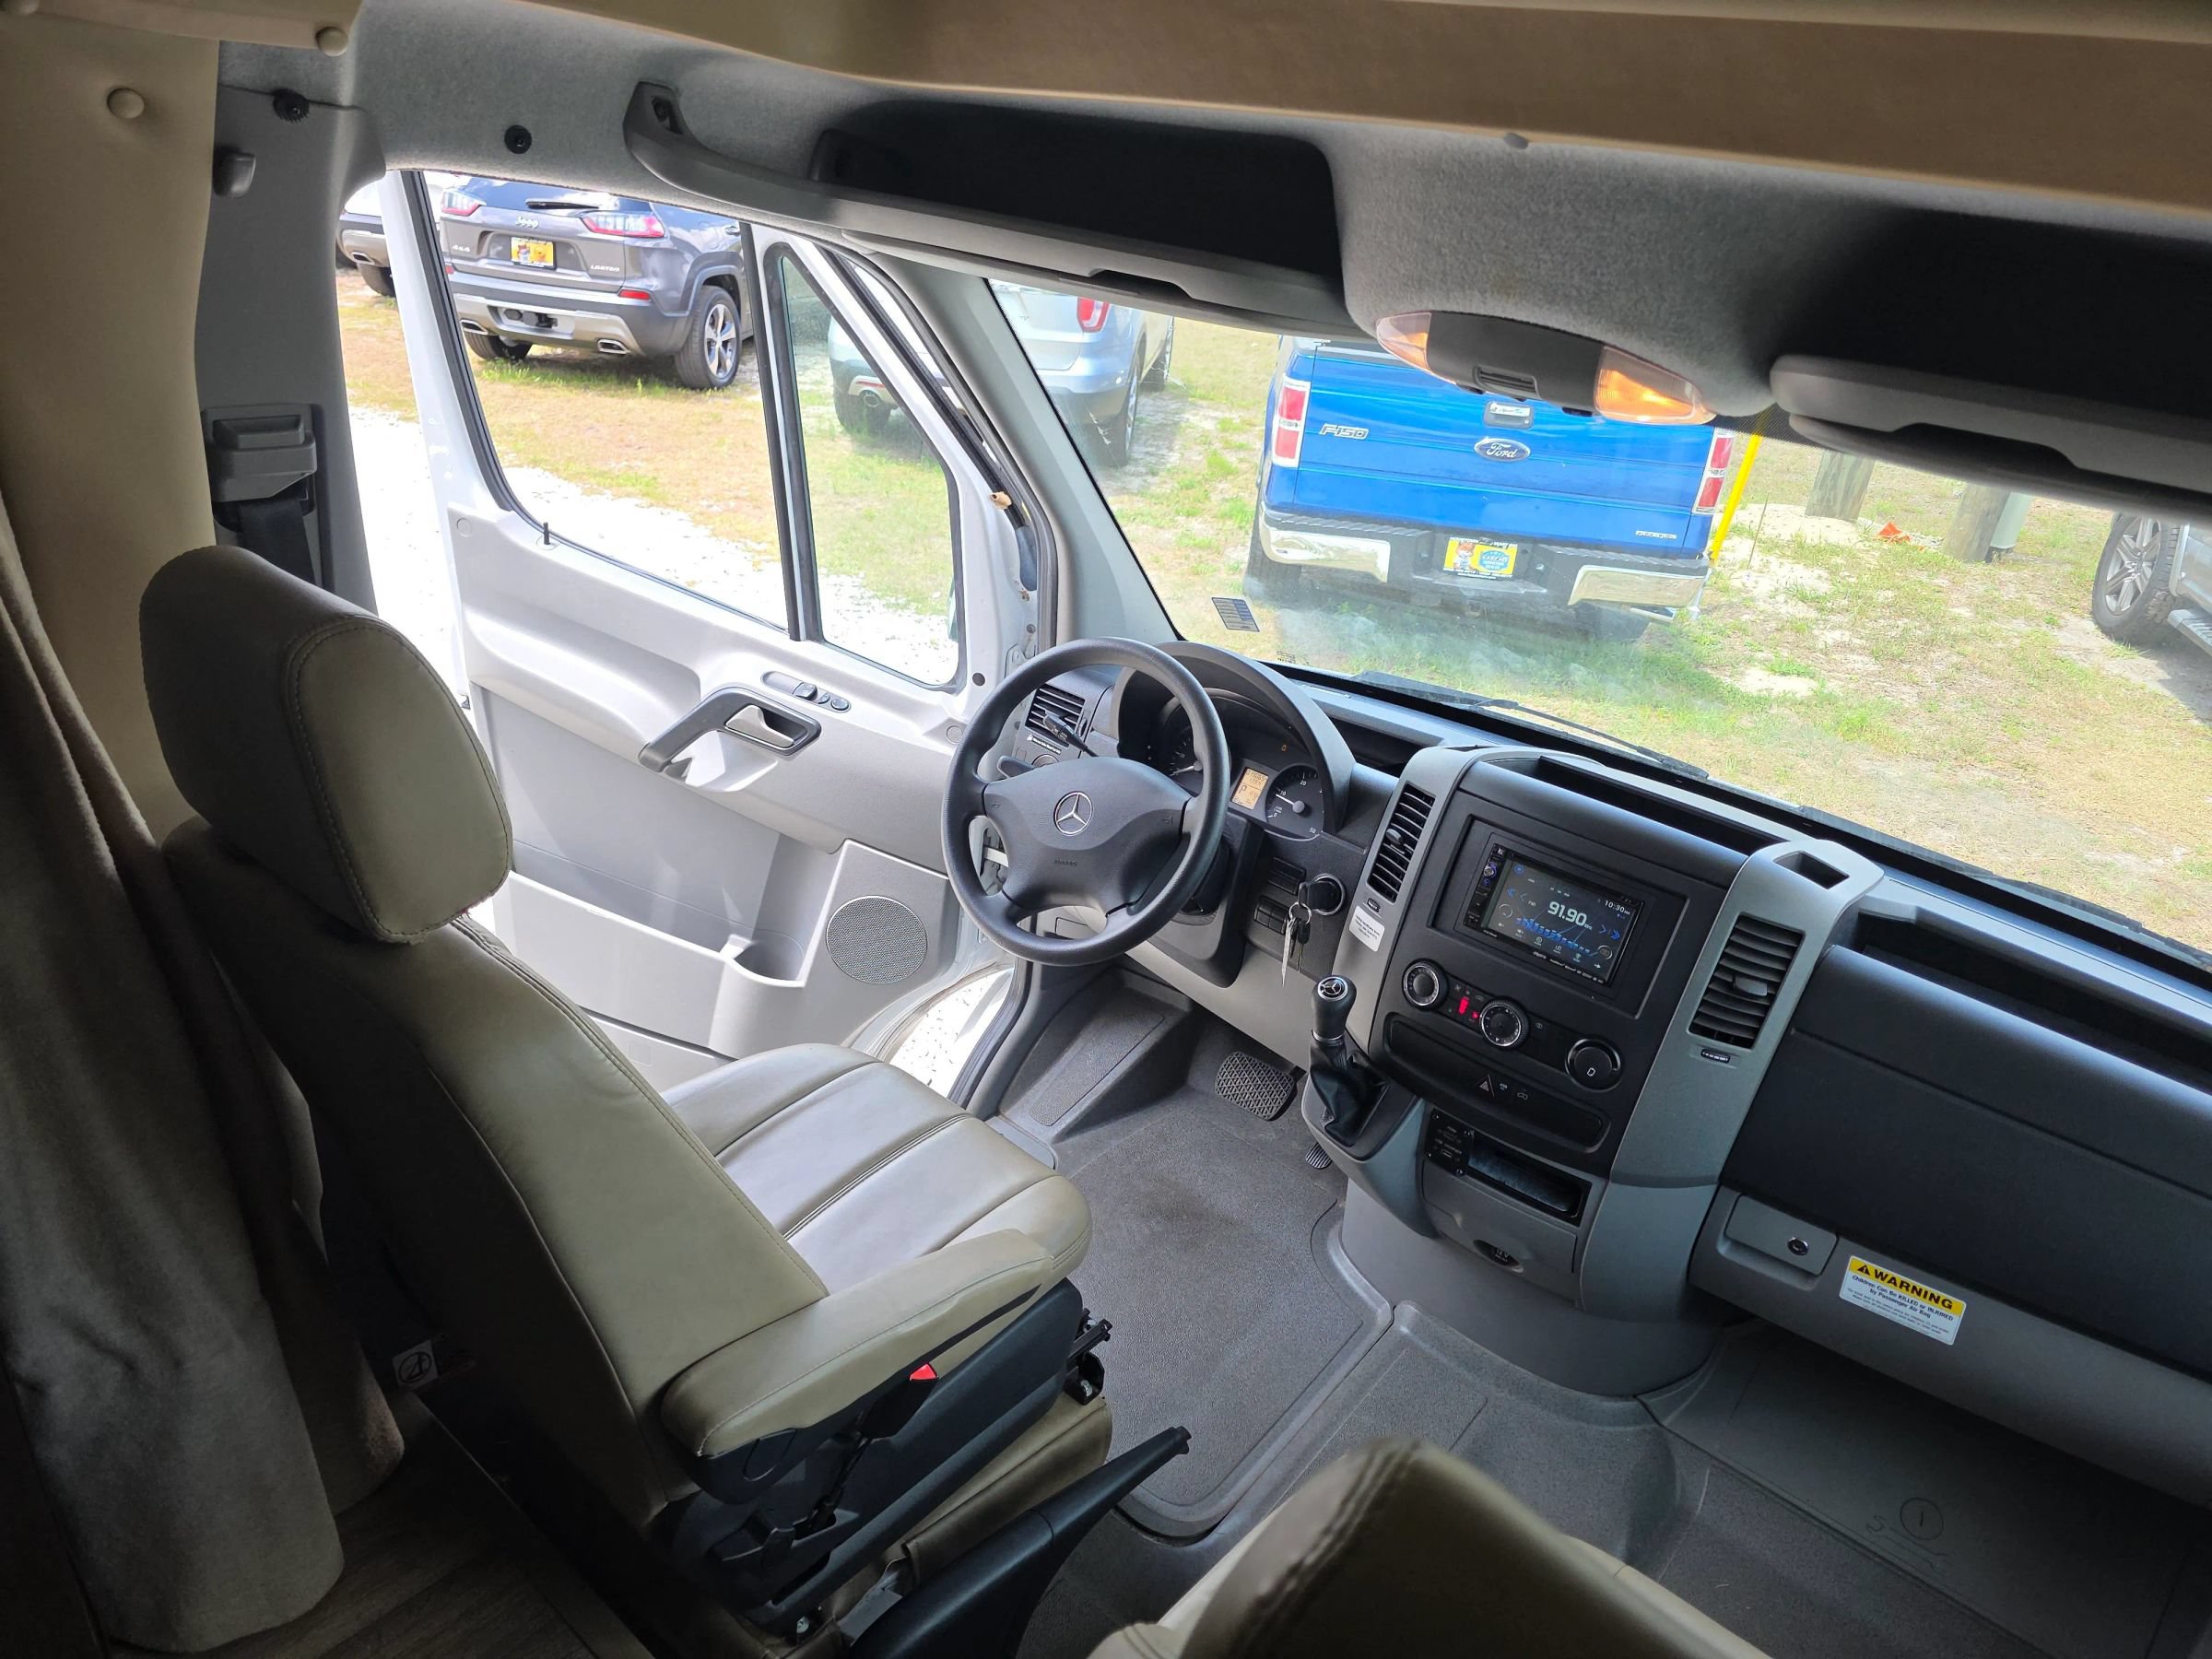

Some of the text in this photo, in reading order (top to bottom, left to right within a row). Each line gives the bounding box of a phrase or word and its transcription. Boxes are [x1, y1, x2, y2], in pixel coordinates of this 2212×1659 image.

[516, 216, 539, 229] Jeep
[1486, 442, 1519, 457] Ford
[1547, 900, 1587, 927] 91.90
[1605, 900, 1625, 912] 10:30
[1874, 1268, 1953, 1310] WARNING
[1852, 1275, 1876, 1288] Children
[1899, 1294, 1919, 1307] KILLED
[1927, 1306, 1954, 1322] INJURED
[1878, 1291, 1908, 1309] Passenger
